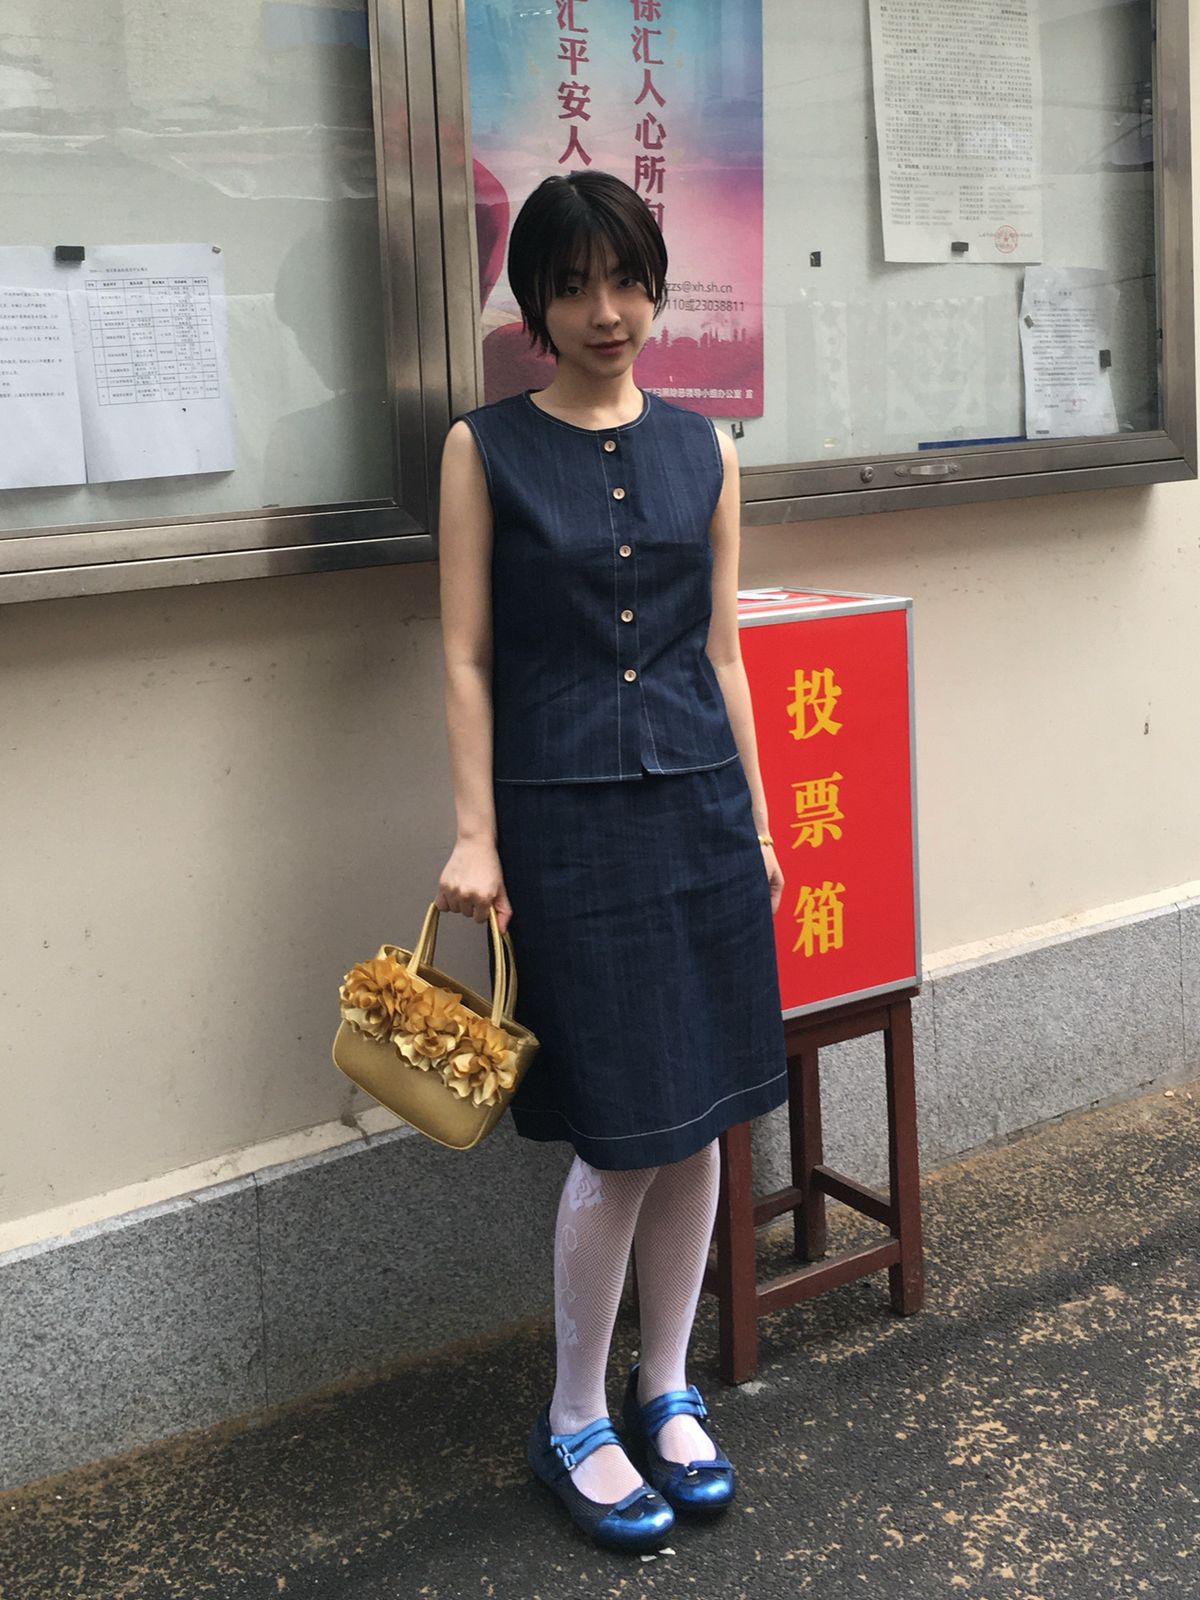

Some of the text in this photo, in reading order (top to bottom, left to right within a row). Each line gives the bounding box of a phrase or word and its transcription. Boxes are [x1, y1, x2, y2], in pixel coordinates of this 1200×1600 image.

[556, 0, 592, 175] 汇平安人
[786, 667, 846, 957] 投票箱
